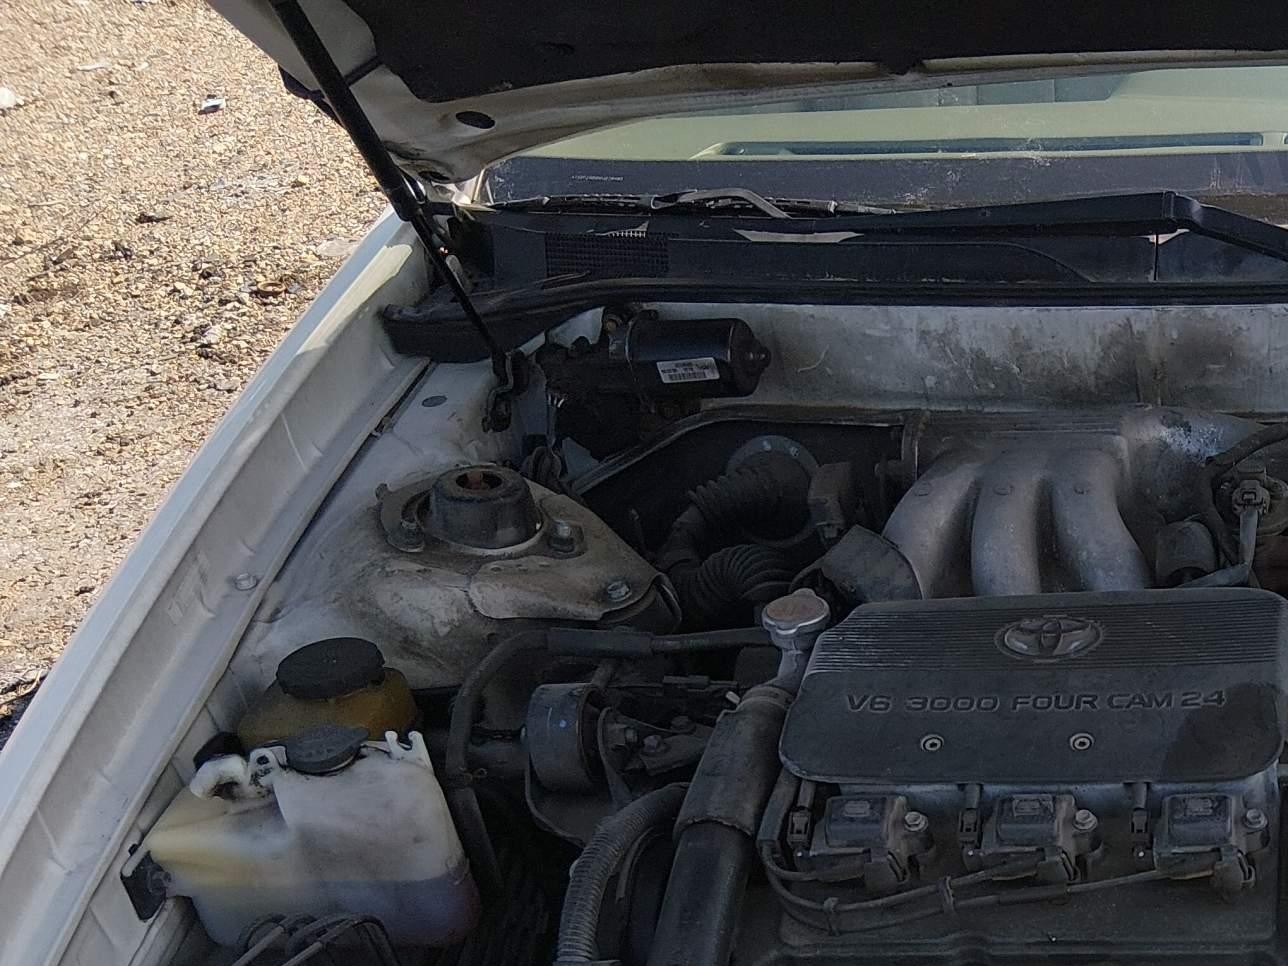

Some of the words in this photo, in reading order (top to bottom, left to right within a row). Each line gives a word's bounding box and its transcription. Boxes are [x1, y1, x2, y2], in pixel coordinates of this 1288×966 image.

[846, 693, 892, 712] V6
[904, 693, 1000, 712] 3000
[1010, 692, 1099, 712] FOUR
[1106, 692, 1174, 710] CAM
[1179, 689, 1227, 709] 24
